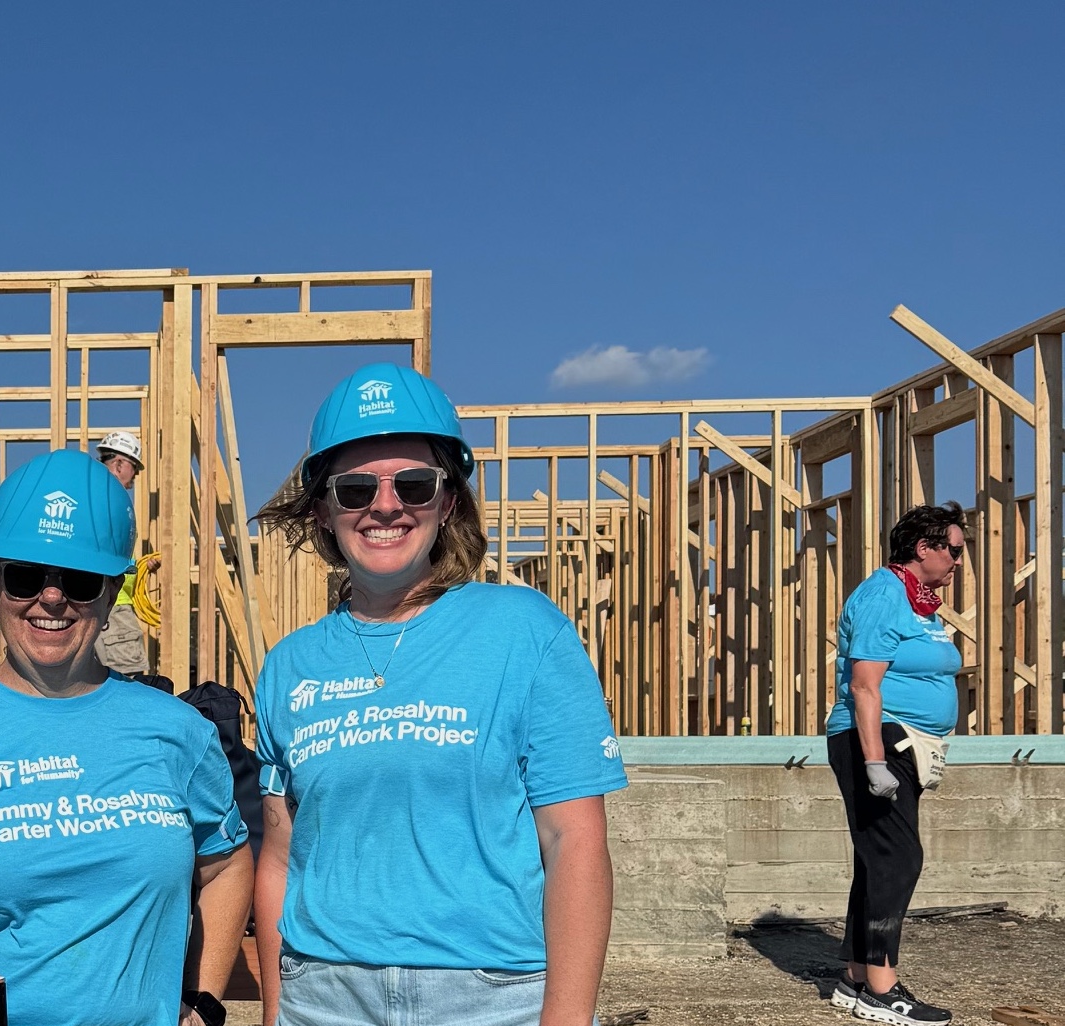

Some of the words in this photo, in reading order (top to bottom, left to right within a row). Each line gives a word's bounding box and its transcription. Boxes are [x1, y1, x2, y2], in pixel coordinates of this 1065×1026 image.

[358, 400, 395, 413] Habitat
[38, 517, 74, 533] Habitat
[321, 691, 334, 701] for
[290, 715, 342, 748] Jimmy
[344, 710, 359, 727] &
[363, 700, 467, 724] Rosalynn
[289, 737, 336, 769] Carter
[339, 722, 393, 748] Work
[18, 754, 79, 776] Habitat
[20, 775, 34, 785] for
[37, 769, 80, 781] Humanity
[57, 796, 74, 816] &
[76, 789, 175, 815] Rosalynn
[55, 813, 120, 837] Work
[120, 808, 188, 828] Project
